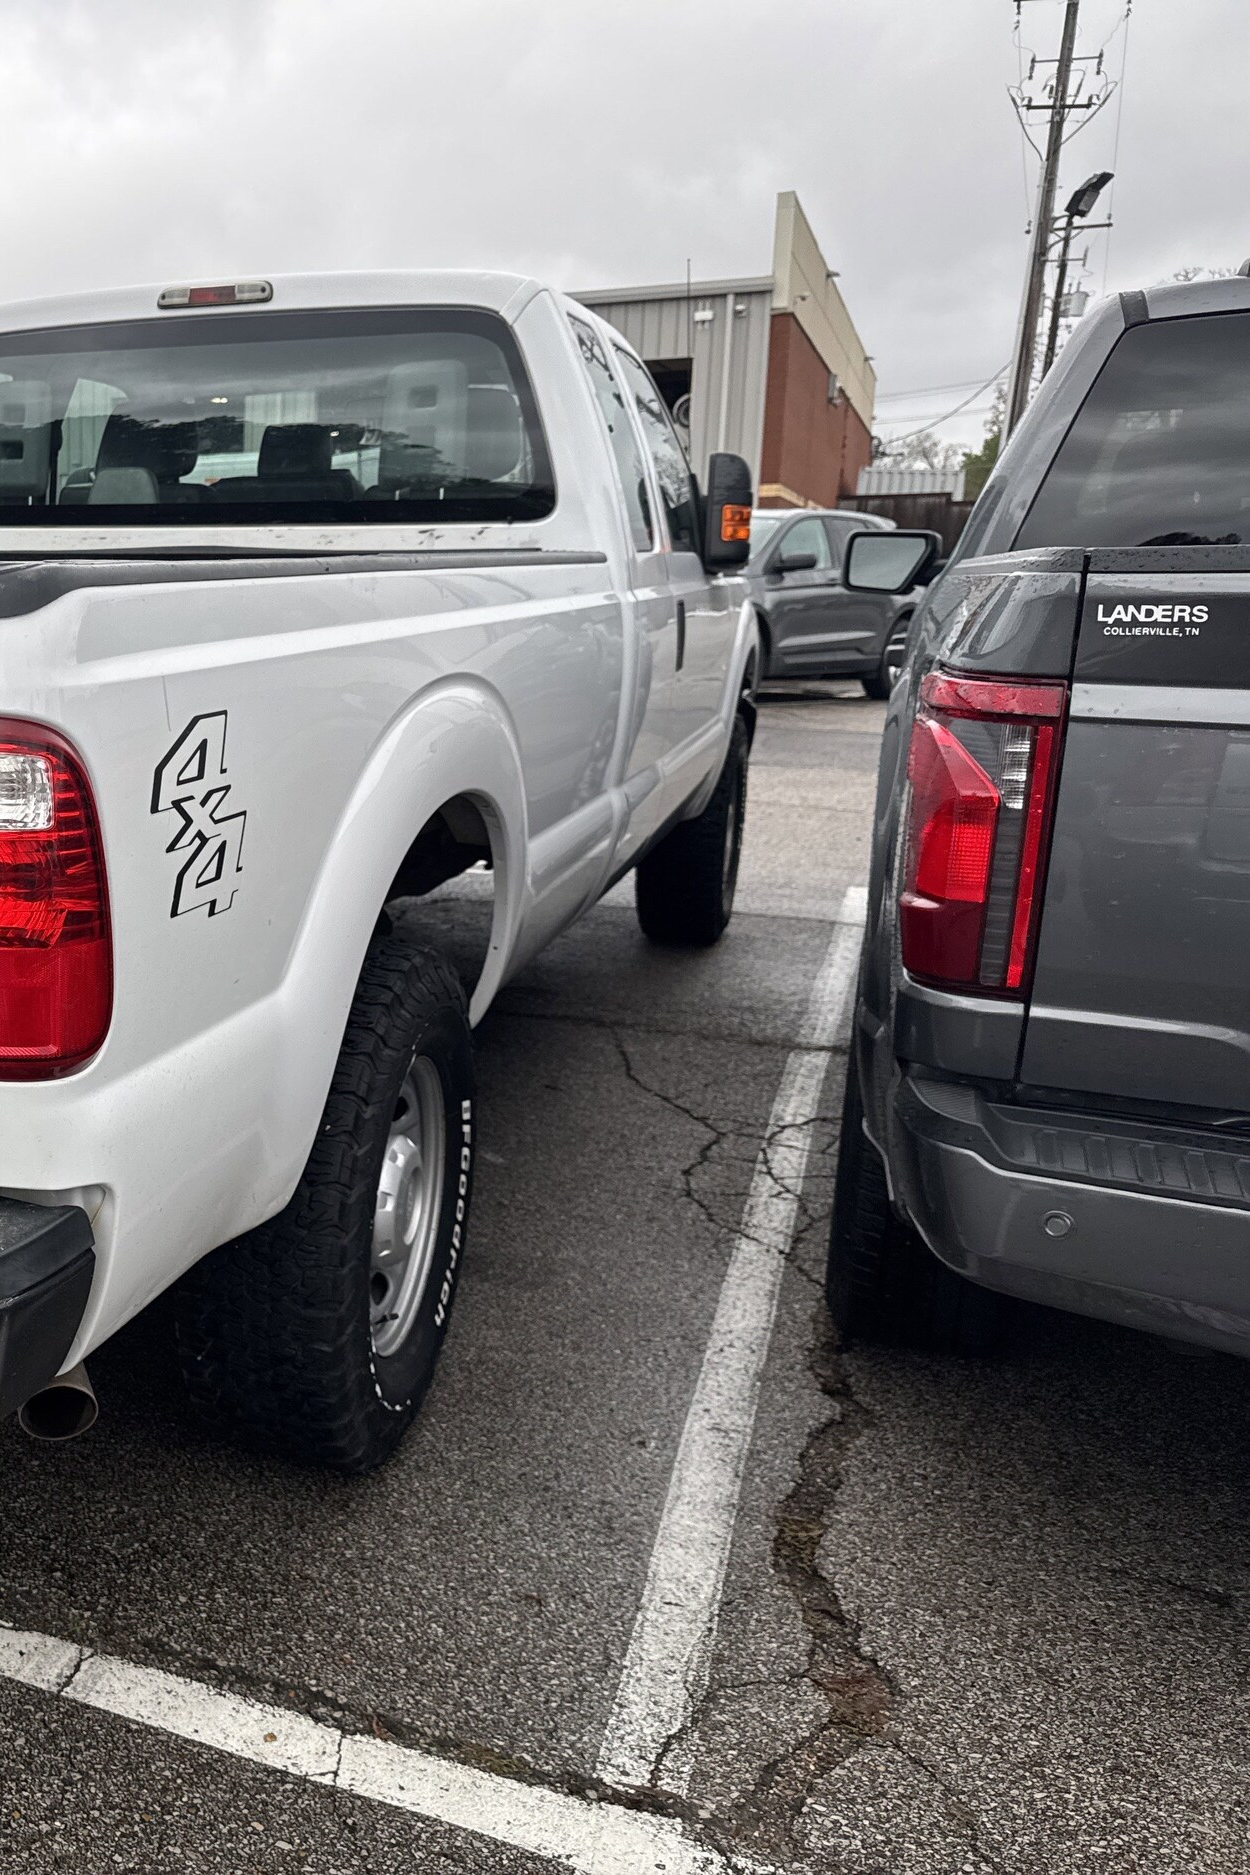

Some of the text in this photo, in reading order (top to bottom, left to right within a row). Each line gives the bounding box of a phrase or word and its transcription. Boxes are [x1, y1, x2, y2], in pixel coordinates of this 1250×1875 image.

[1097, 604, 1209, 624] LANDERS
[1103, 627, 1200, 637] COLLIERVILLE, TN
